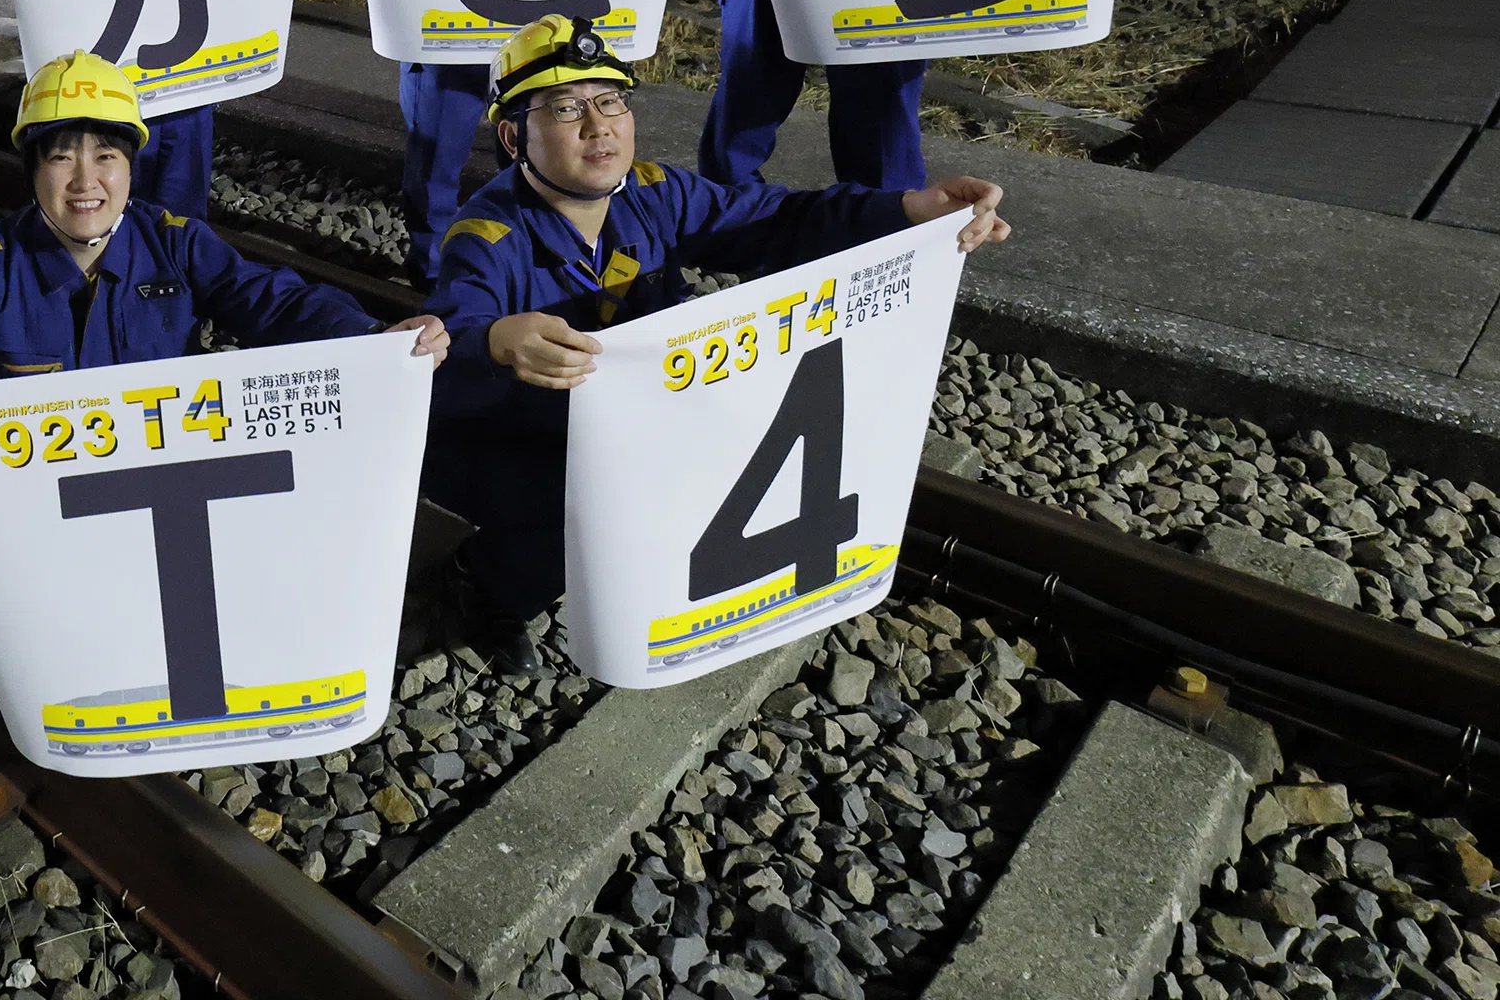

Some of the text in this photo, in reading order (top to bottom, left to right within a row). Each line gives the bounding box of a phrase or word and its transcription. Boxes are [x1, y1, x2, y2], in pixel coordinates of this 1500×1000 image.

[61, 81, 97, 99] JR
[850, 249, 916, 284] 東海道新幹線
[845, 291, 911, 328] 2025.1
[847, 276, 910, 313] LAST RUN
[663, 277, 838, 392] 923 T4
[666, 311, 757, 348] SHINKANSEN Class
[241, 367, 341, 392] 東海道新幹線
[77, 396, 110, 410] Class
[122, 379, 233, 450] T4
[244, 399, 342, 424] LAST RUN
[246, 414, 343, 440] 2025.1
[688, 336, 859, 602] 4
[58, 449, 295, 721] T
